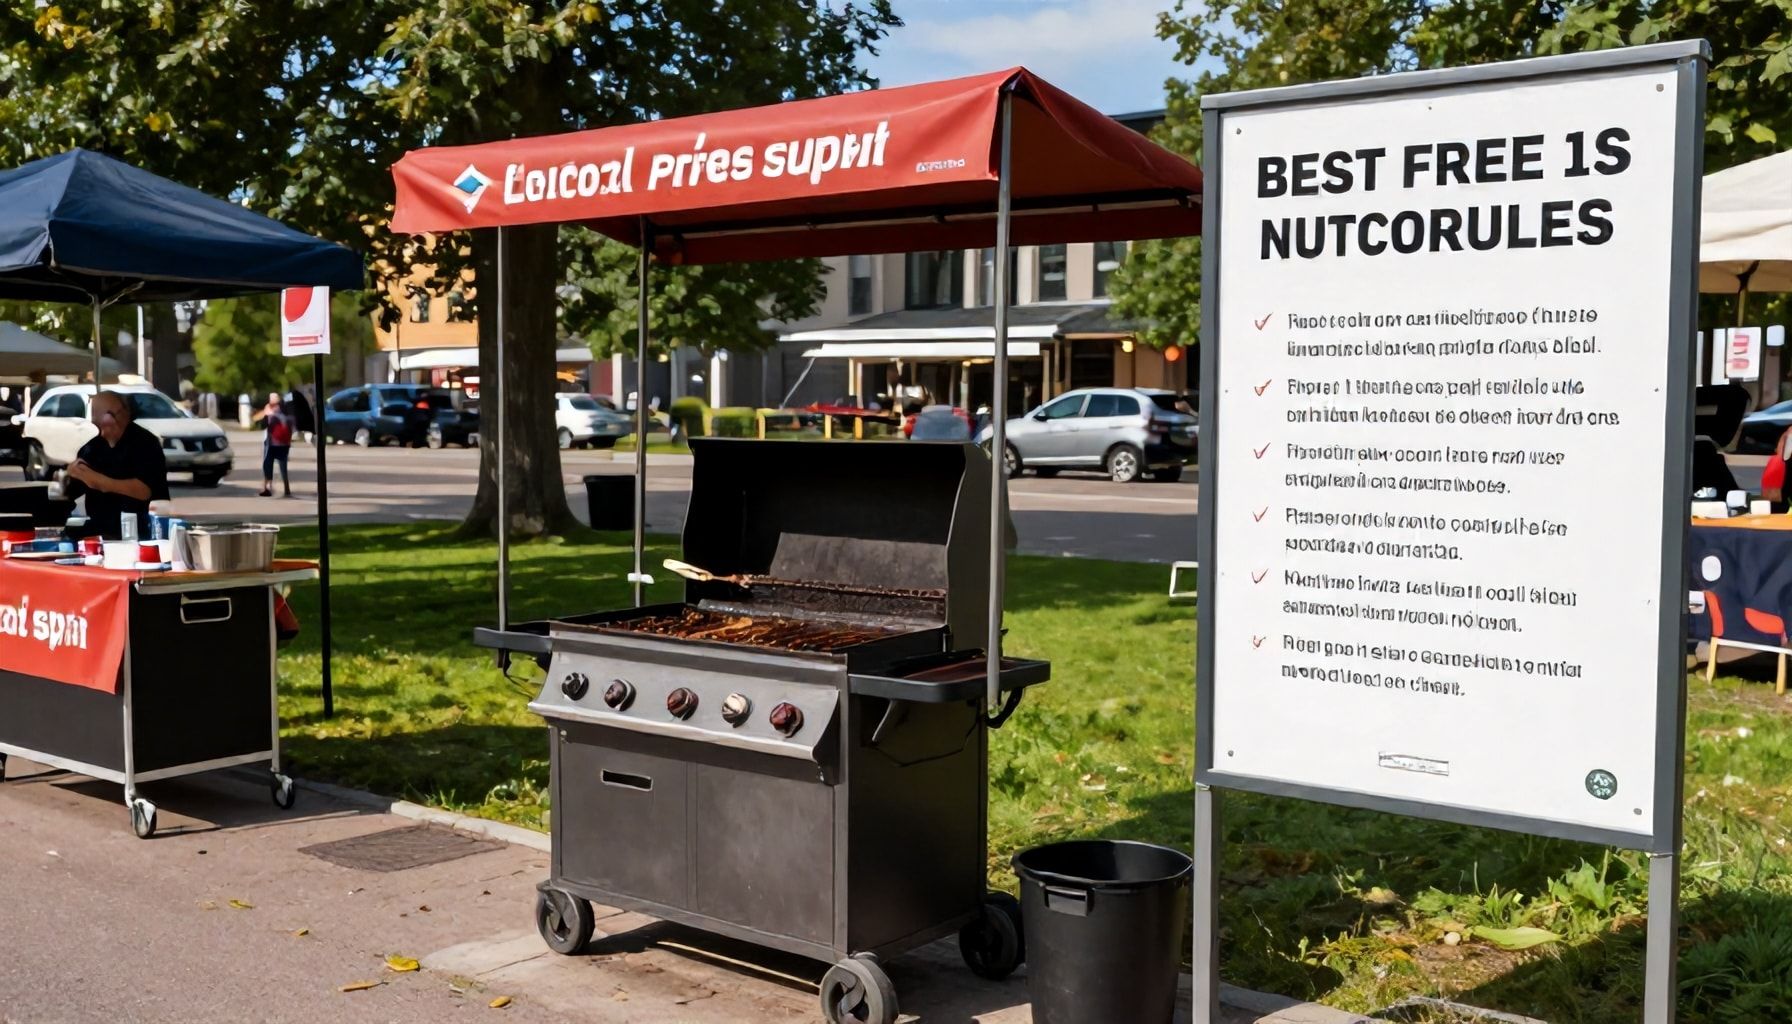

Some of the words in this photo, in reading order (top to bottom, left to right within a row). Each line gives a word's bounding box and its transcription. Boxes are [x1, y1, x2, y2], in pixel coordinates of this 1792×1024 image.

[1258, 149, 1386, 198] BEST
[1403, 135, 1544, 189] FREE
[1564, 128, 1631, 178] 1S
[1260, 198, 1614, 260] NUTCORULES
